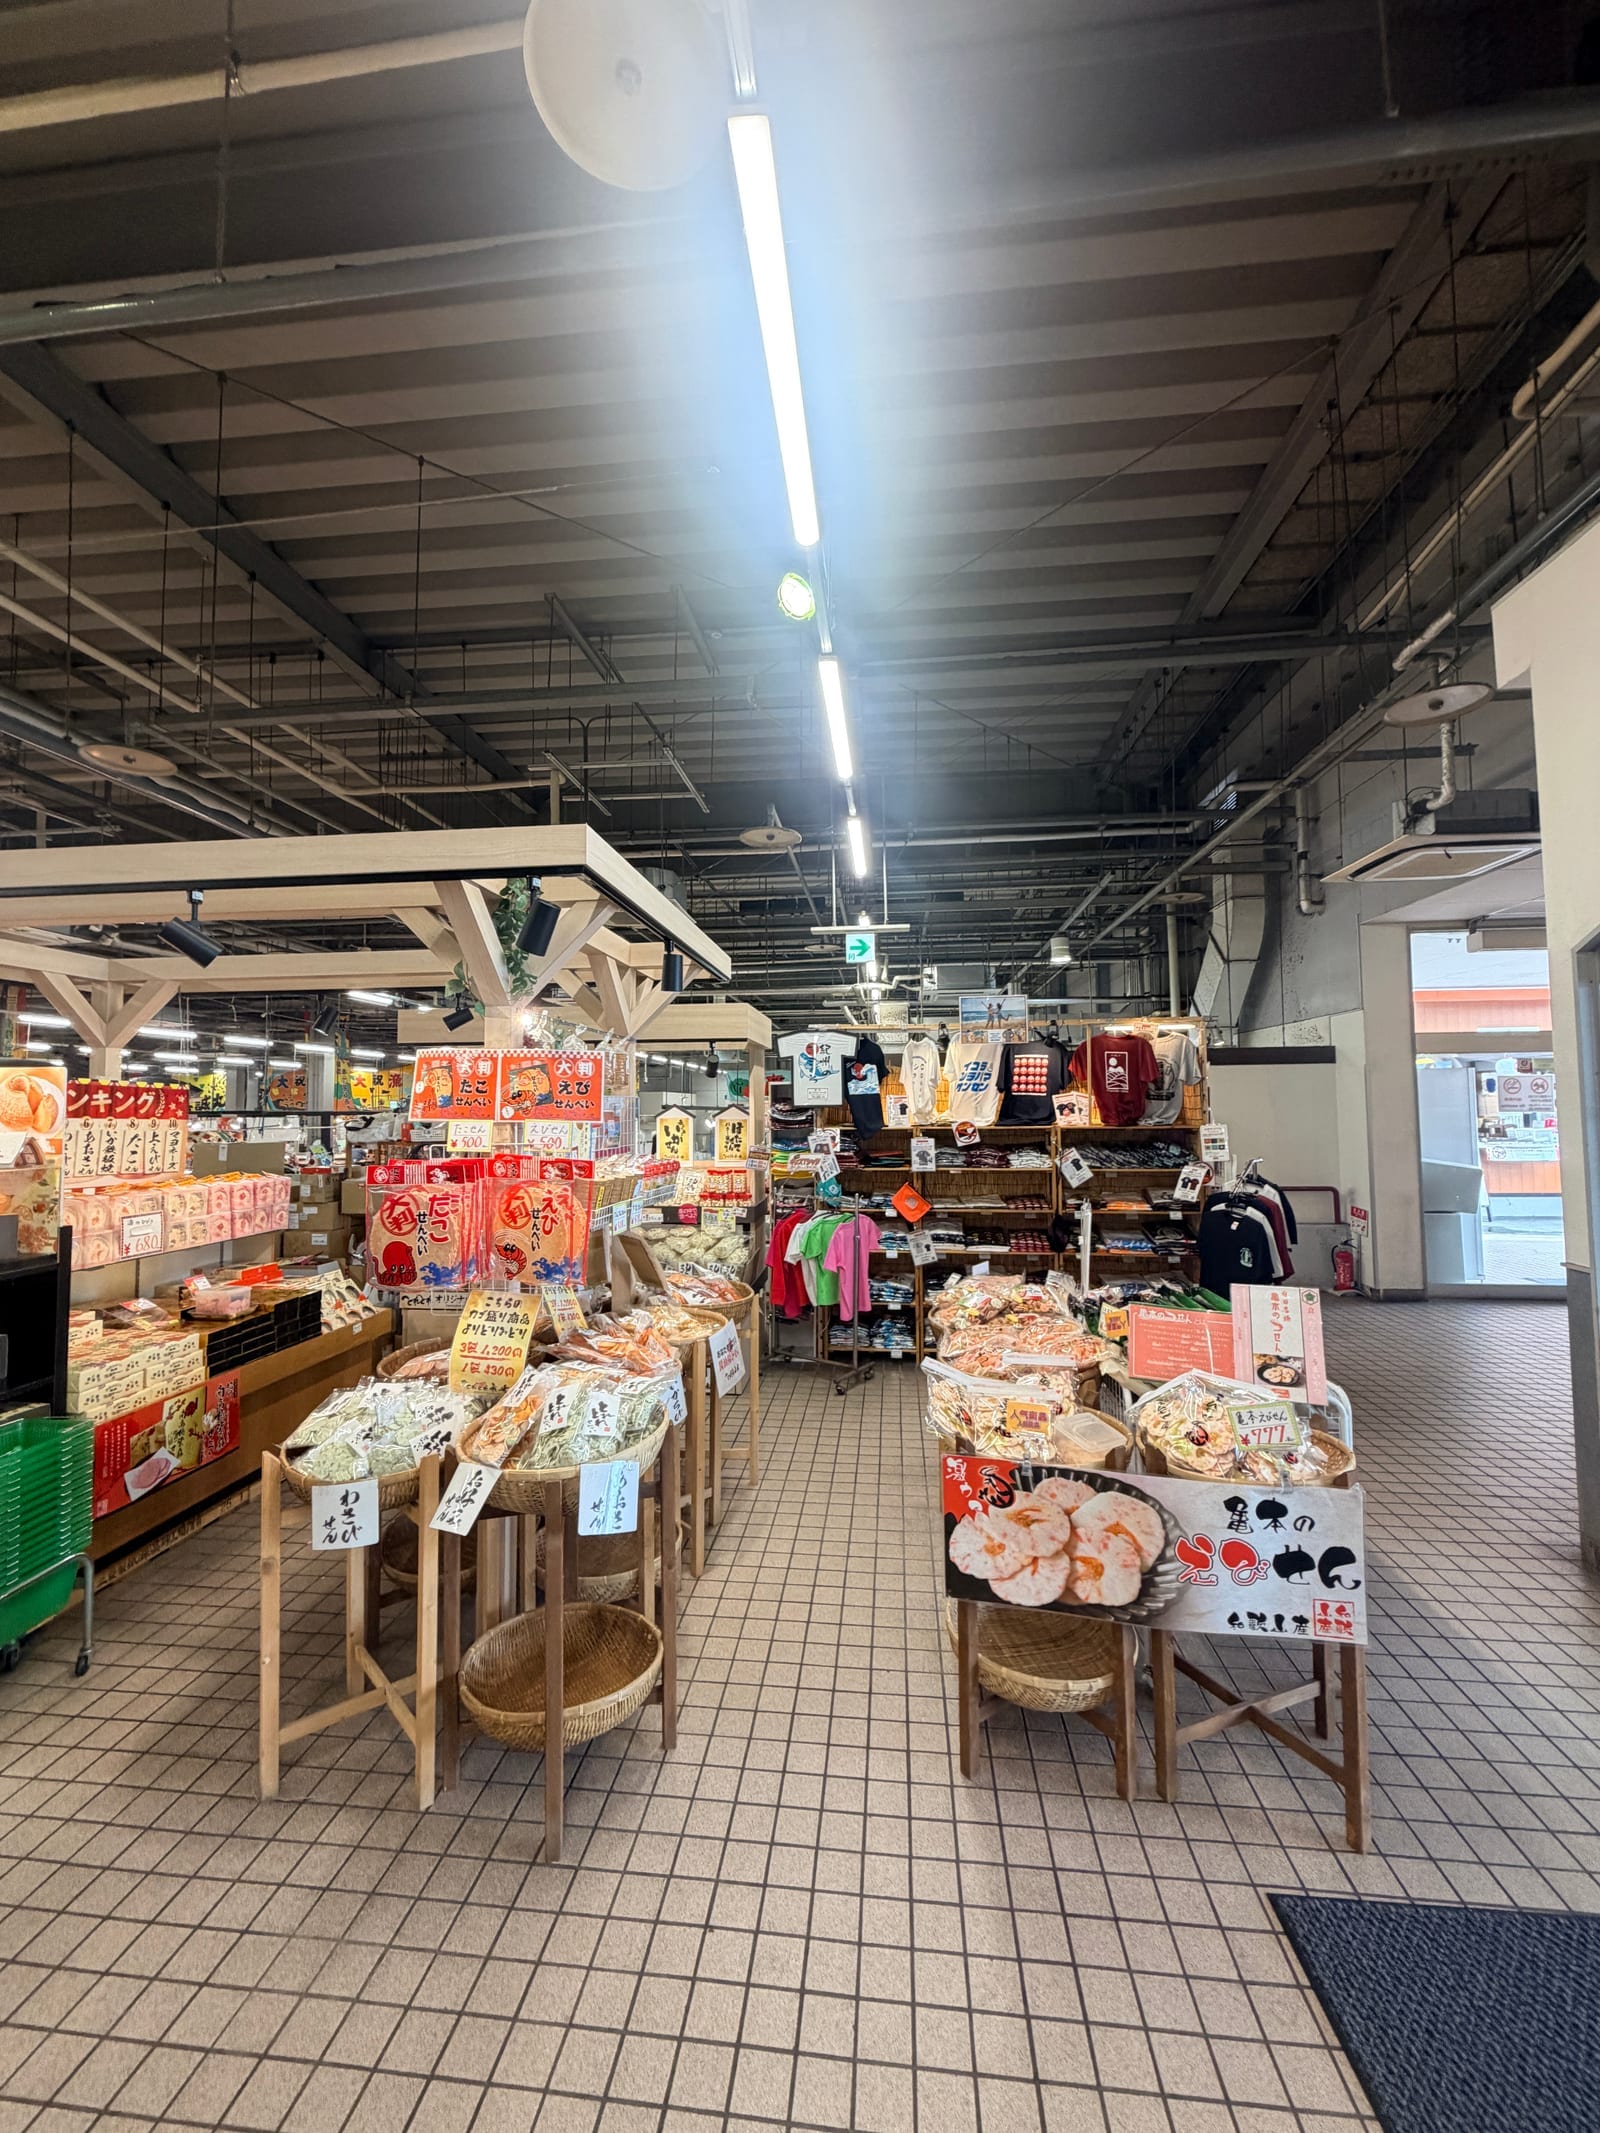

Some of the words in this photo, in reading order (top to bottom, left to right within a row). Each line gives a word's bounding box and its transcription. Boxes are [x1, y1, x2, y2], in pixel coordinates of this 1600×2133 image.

[555, 1059, 594, 1077] 大判
[461, 1079, 488, 1094] たこ
[559, 1080, 591, 1095] えび
[456, 1097, 492, 1106] せんべい
[555, 1099, 594, 1109] せんべい
[452, 1124, 486, 1135] たこせん
[530, 1124, 568, 1135] えびせん
[428, 1194, 451, 1243] たこ
[541, 1189, 559, 1236] えび
[416, 1211, 428, 1256] せんべい
[530, 1208, 541, 1252] せんべい
[435, 1294, 467, 1304] オリジナ
[485, 1296, 522, 1309] こちらの
[469, 1310, 530, 1325] カゴ盛り商品
[461, 1323, 528, 1340] よりどりみどり
[1235, 1410, 1288, 1426] 亀本えびせん
[339, 1488, 363, 1544] わさび
[1223, 1495, 1316, 1534] 亀本の
[322, 1515, 338, 1545] せん
[1174, 1533, 1362, 1591] えびせん
[1227, 1611, 1310, 1637] 和歌山産
